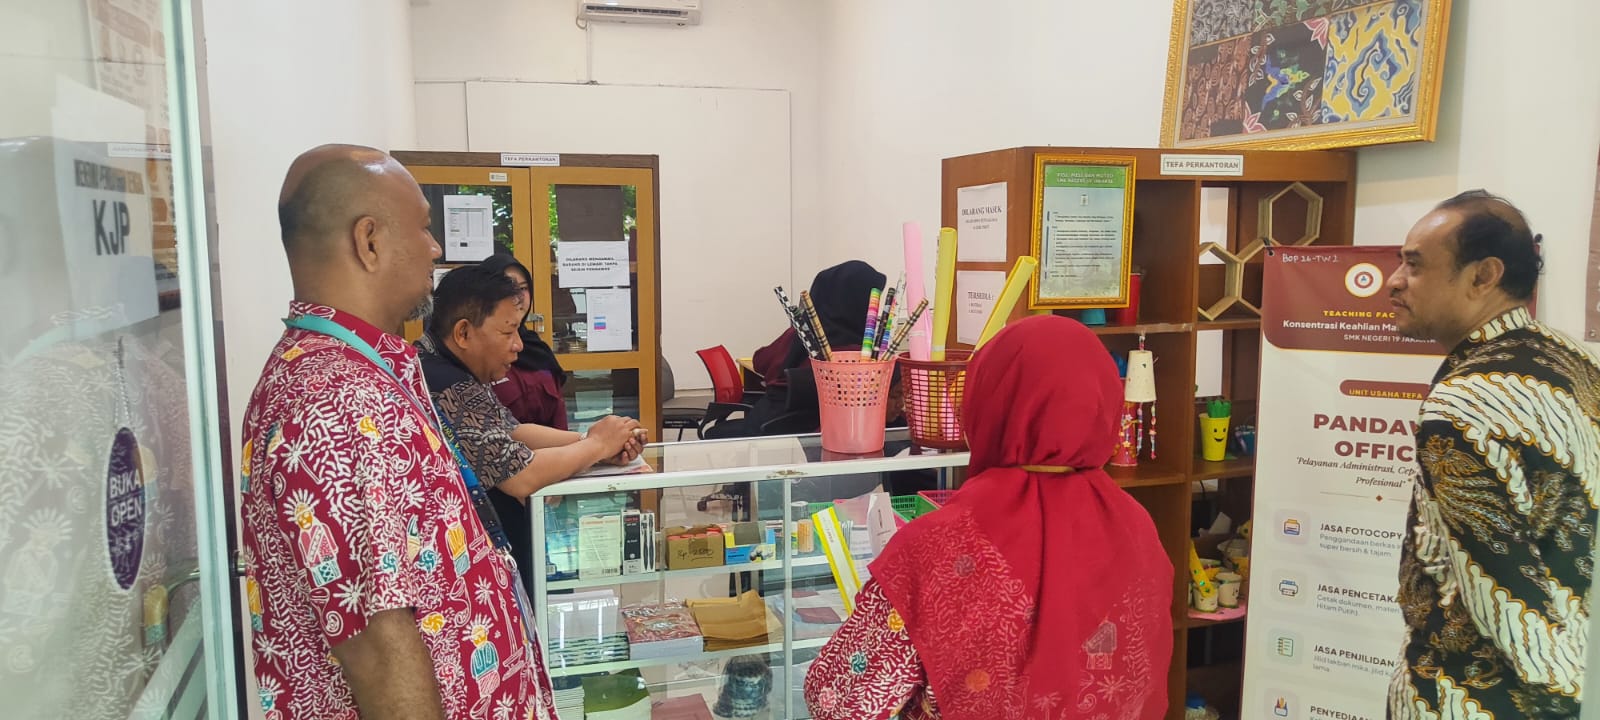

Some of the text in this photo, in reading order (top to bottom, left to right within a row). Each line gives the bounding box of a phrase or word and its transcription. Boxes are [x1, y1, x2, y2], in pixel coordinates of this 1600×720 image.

[962, 206, 984, 216] DILARANG
[92, 200, 130, 256] KJP
[1282, 320, 1338, 330] Konsentrasi
[1339, 322, 1380, 331] Keahlian
[1370, 390, 1400, 398] USAHA
[110, 469, 142, 499] BUKA
[112, 496, 142, 527] OPEN
[1320, 523, 1402, 540] JASA FOTOCOPY
[1320, 534, 1368, 546] Penggandaan
[1370, 540, 1396, 550] berkas
[1320, 542, 1338, 552] super
[1340, 545, 1362, 554] bersih
[1317, 584, 1398, 602] JASA PENCETAK
[1317, 594, 1337, 605] Cetak
[1316, 602, 1337, 612] Hitam
[1314, 644, 1394, 667] JASA PENJILIDAN
